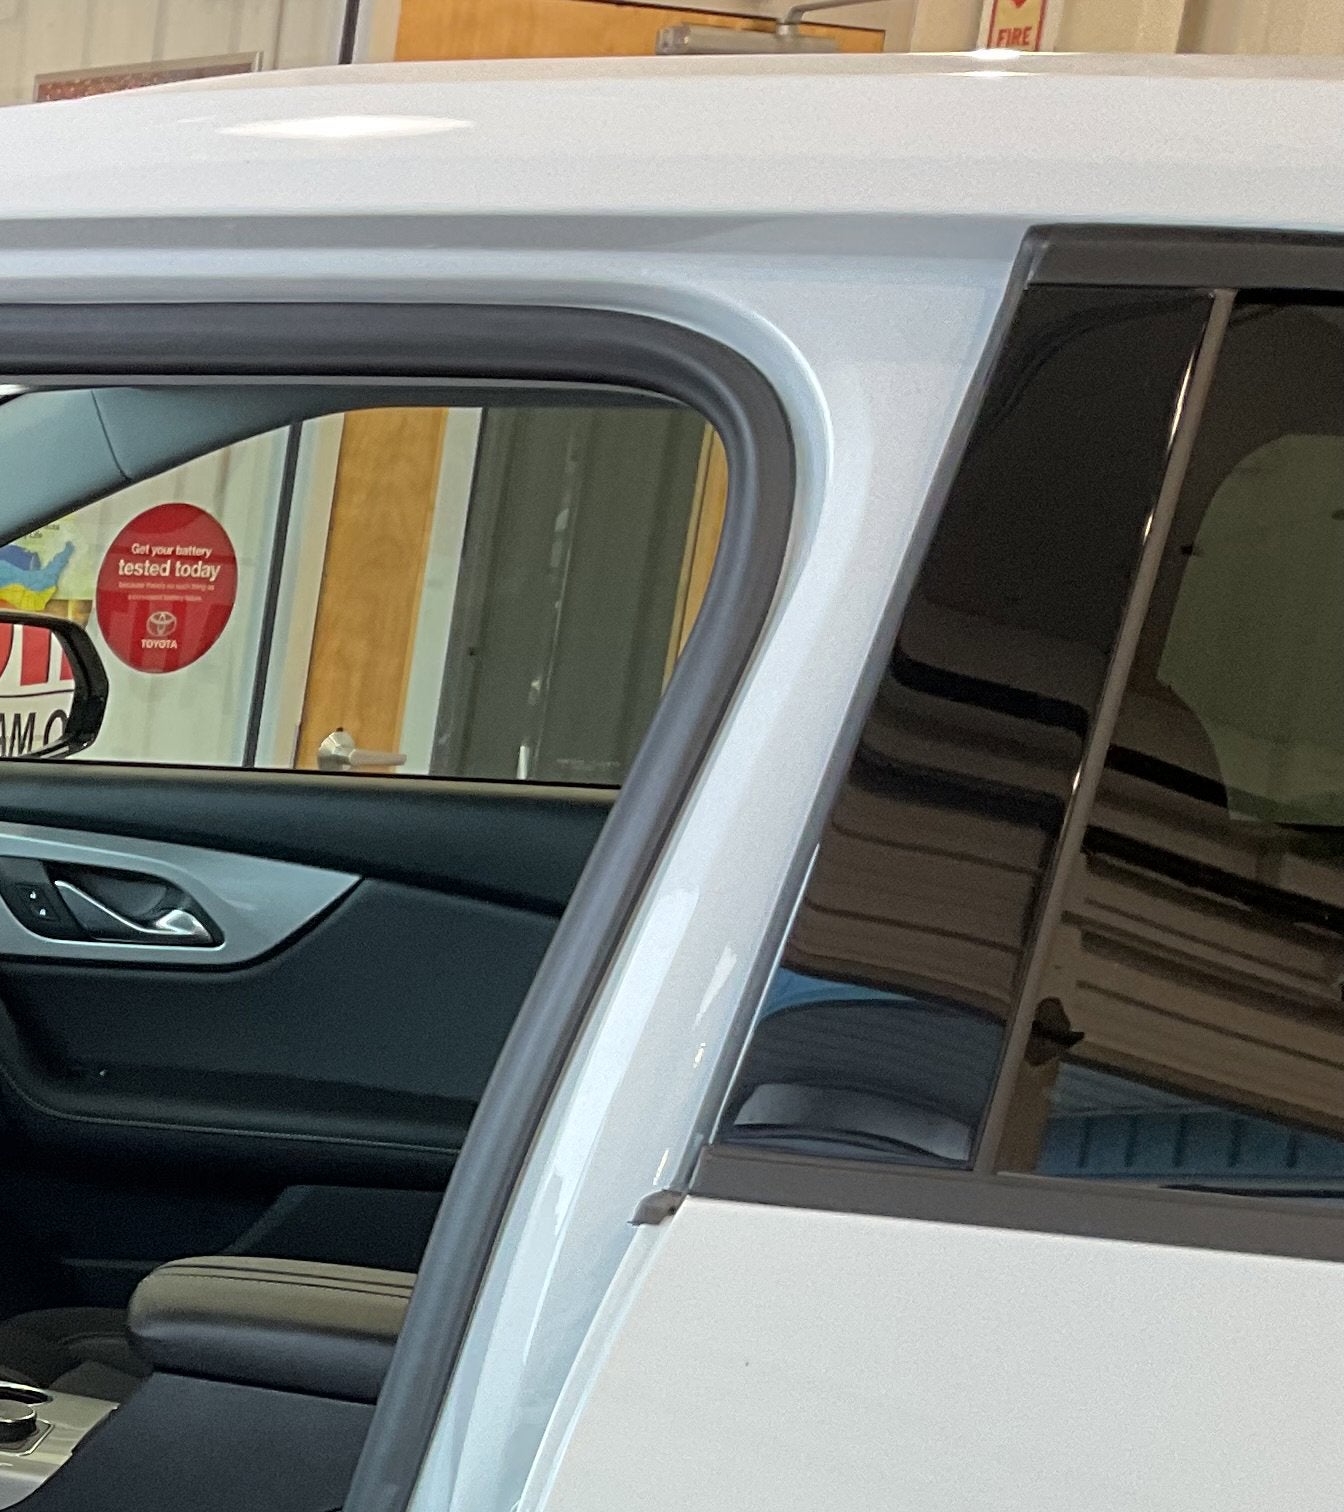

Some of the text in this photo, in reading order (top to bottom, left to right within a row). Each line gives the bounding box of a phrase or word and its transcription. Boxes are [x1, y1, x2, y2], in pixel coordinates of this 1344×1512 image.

[998, 26, 1032, 46] FIRE
[131, 543, 213, 558] Get your battery
[118, 559, 221, 582] tested today
[140, 639, 178, 649] TOYOTA
